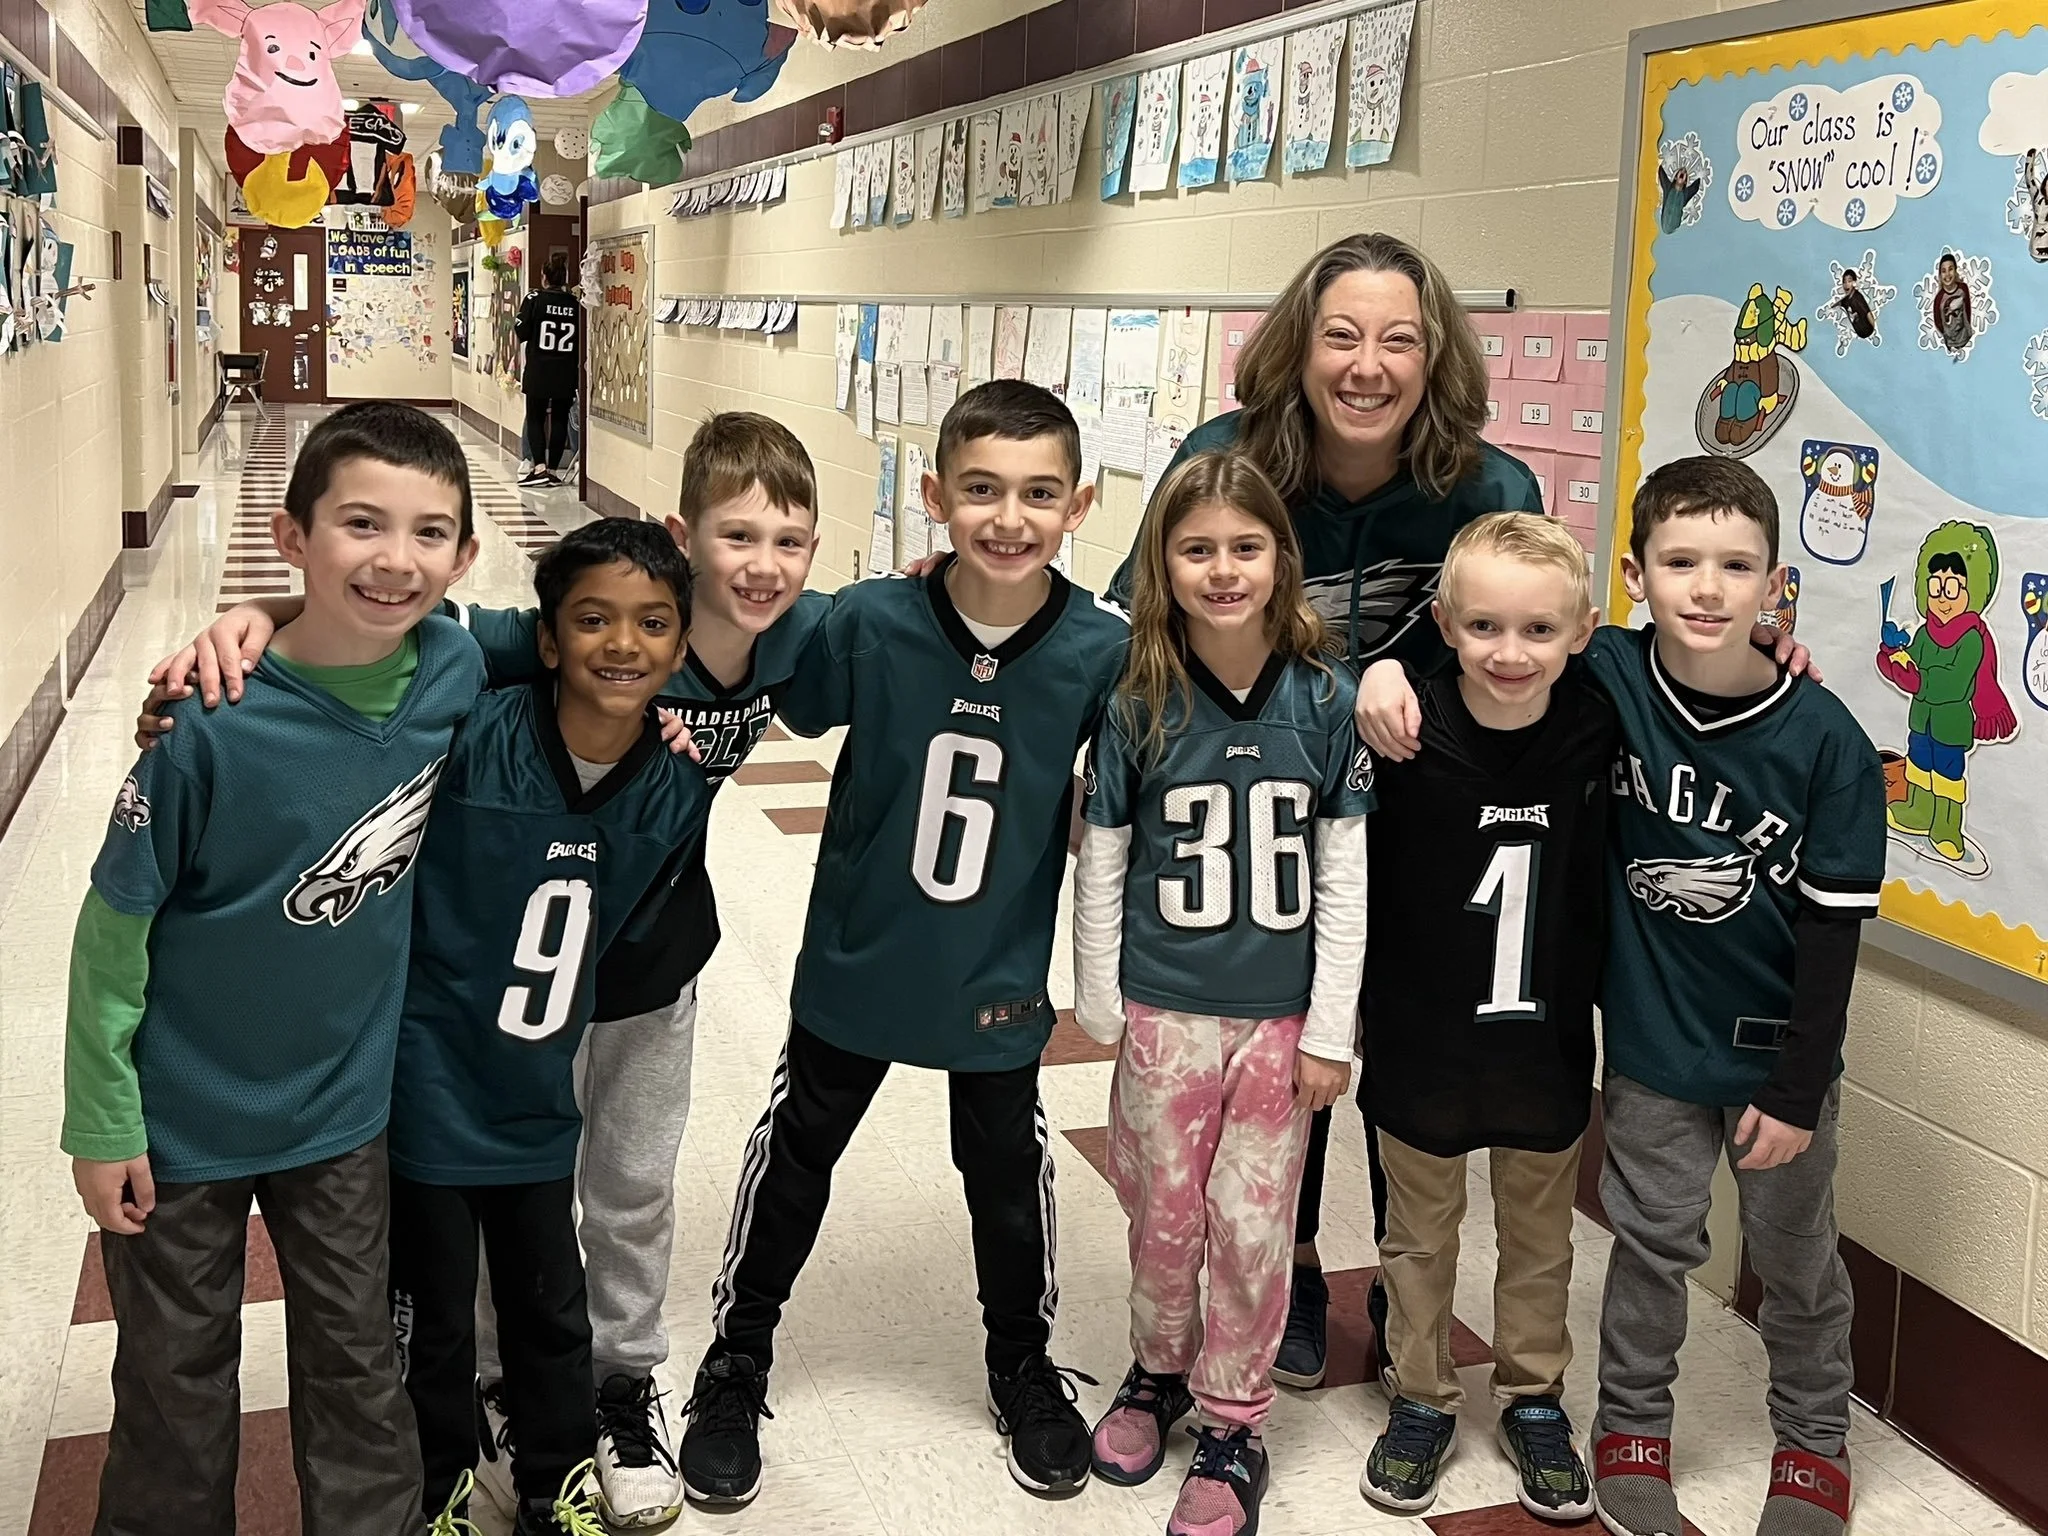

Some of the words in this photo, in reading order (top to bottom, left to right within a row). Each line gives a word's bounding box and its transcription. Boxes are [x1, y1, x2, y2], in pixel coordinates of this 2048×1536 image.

[1751, 117, 1788, 149] Our
[1803, 103, 1855, 145] class
[1876, 102, 1895, 138] is
[330, 231, 348, 242] We
[353, 233, 384, 243] have
[329, 245, 370, 256] LOADS
[373, 245, 387, 257] of
[390, 246, 409, 259] fun
[363, 262, 410, 275] speech
[546, 304, 574, 316] KELCE
[539, 320, 575, 352] 62
[1487, 341, 1493, 352] 8
[1535, 342, 1541, 354] 9
[1587, 345, 1597, 357] 10
[1531, 408, 1541, 420] 19
[1582, 415, 1593, 428] 20
[1579, 486, 1590, 499] 30
[974, 664, 992, 679] NFL
[951, 698, 1002, 723] EAGLES
[1226, 745, 1261, 759] EAGLES
[912, 732, 1003, 902] 6
[1478, 804, 1550, 829] EAGLES
[1157, 780, 1313, 931] 36
[1468, 842, 1540, 1018] 1
[498, 879, 593, 1041] 9
